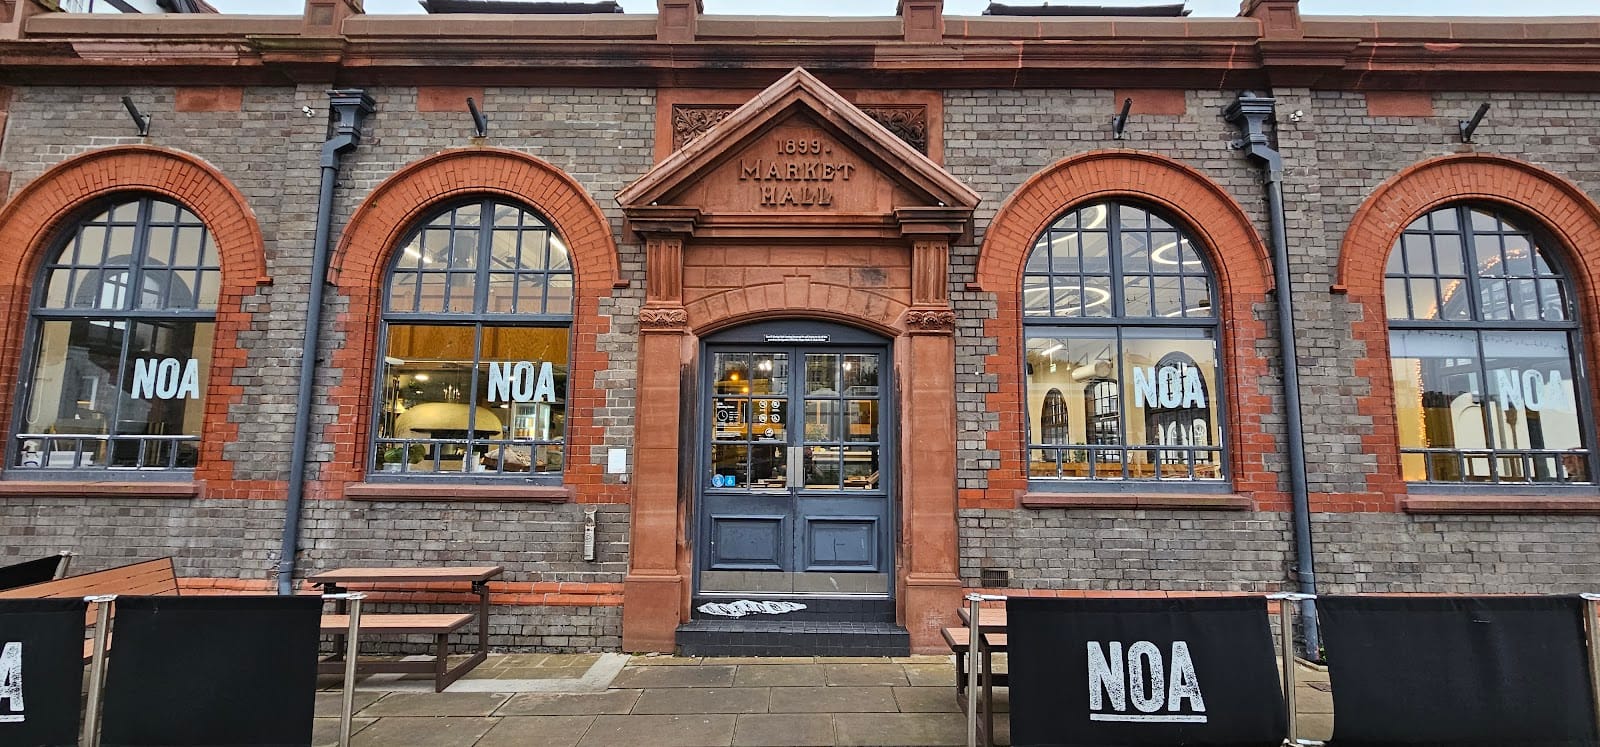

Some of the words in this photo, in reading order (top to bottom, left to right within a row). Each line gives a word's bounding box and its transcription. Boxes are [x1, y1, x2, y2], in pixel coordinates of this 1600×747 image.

[738, 159, 856, 181] MARKET
[760, 185, 833, 207] HALL
[130, 357, 199, 400] NOA
[487, 360, 556, 403] NOA
[1132, 365, 1207, 409] NOA
[1496, 368, 1571, 413] NOA
[1086, 640, 1206, 713] NOA
